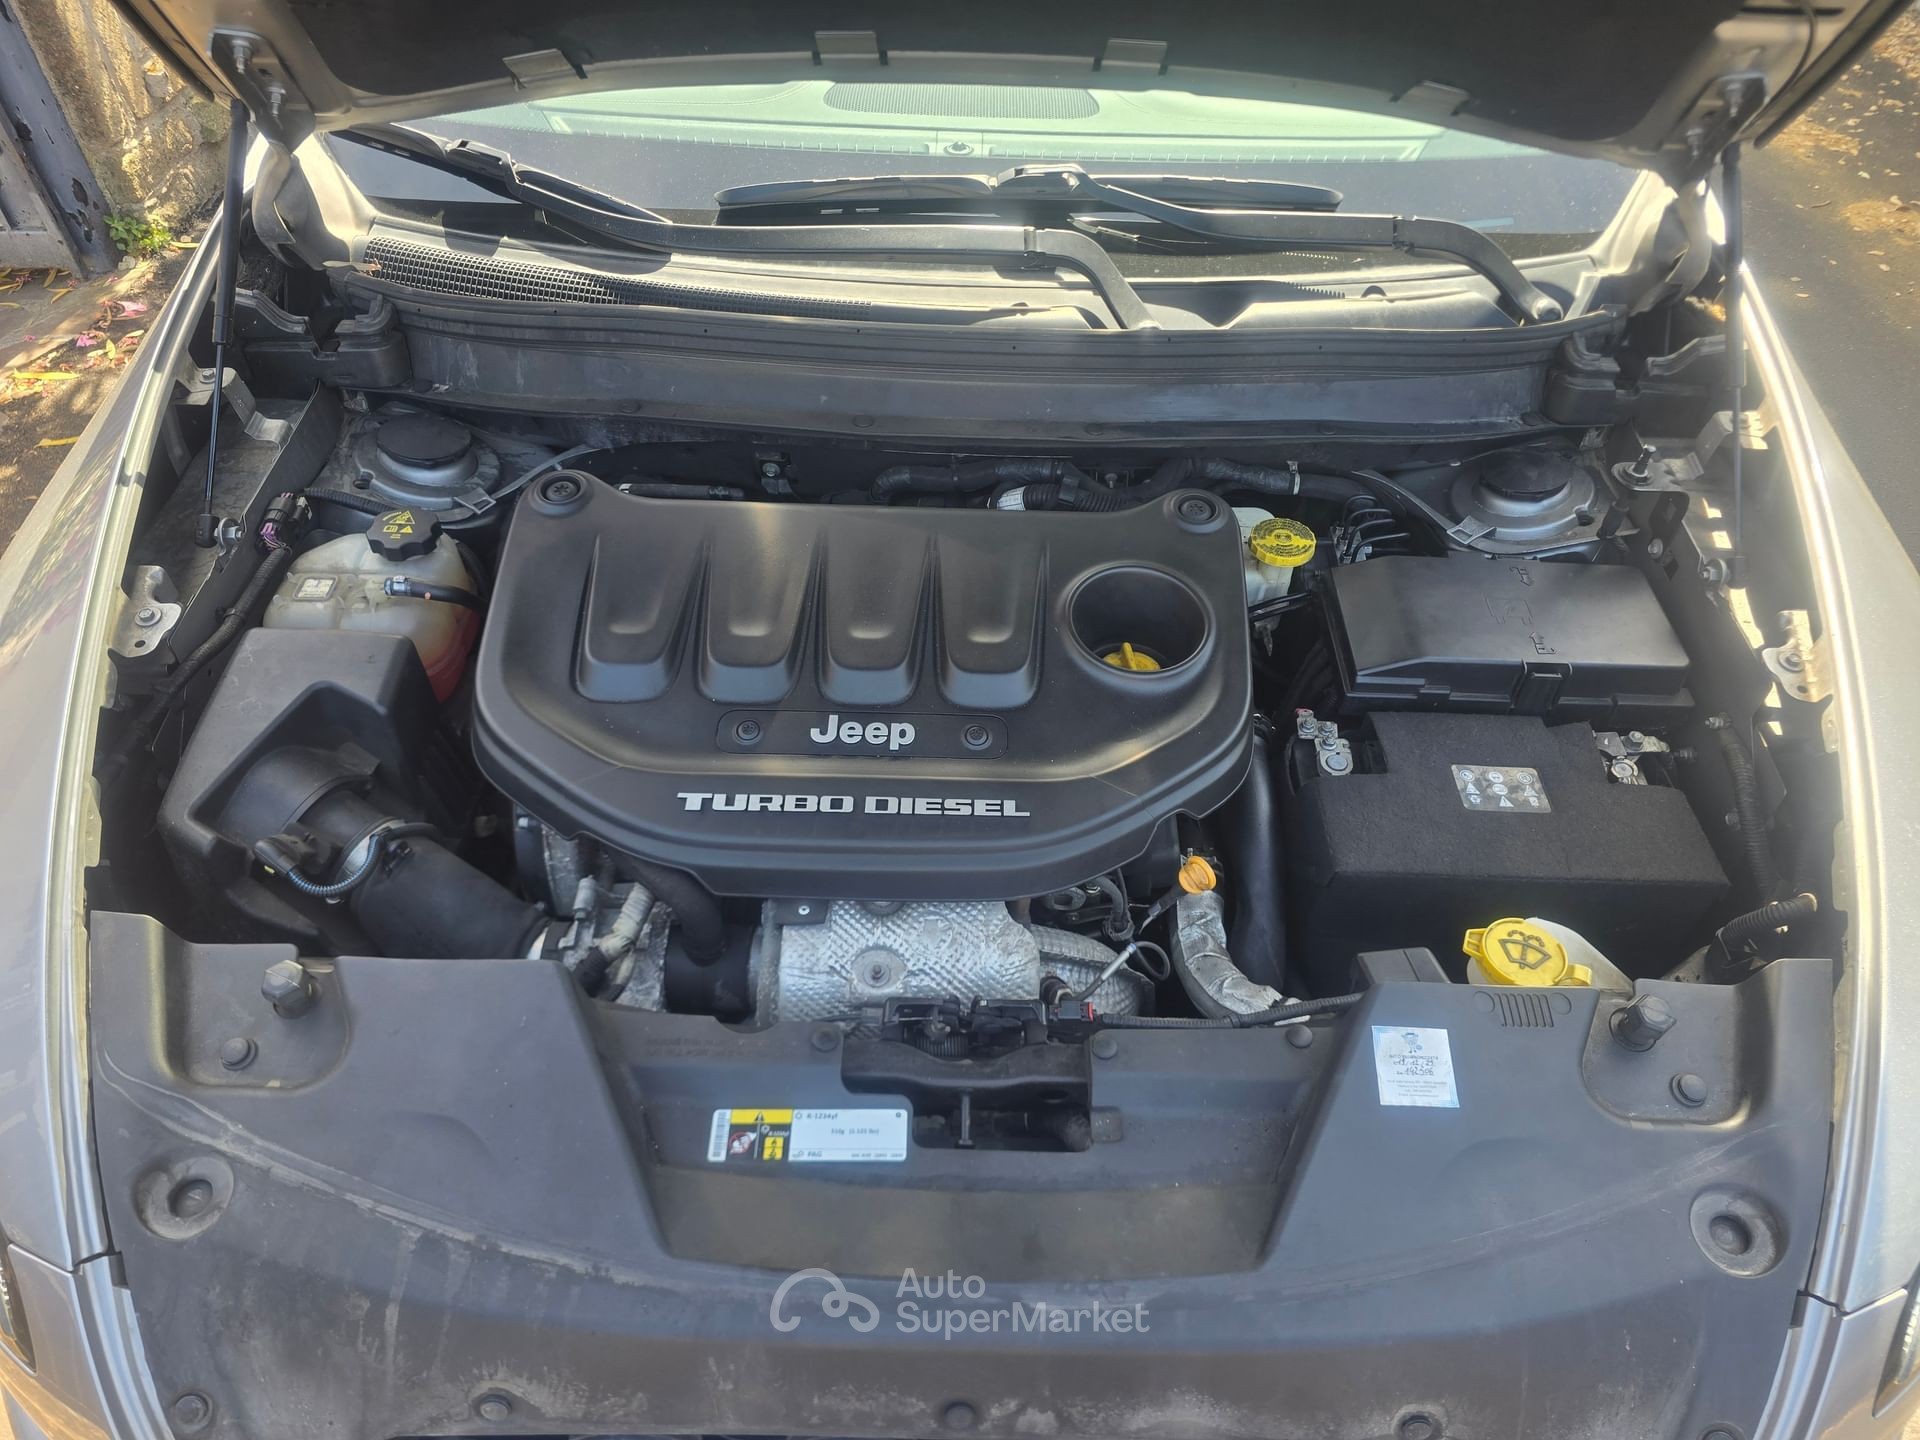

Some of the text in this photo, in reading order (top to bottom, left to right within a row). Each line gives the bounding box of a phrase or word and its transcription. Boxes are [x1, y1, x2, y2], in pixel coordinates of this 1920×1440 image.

[810, 714, 915, 750] Jeep
[677, 792, 1031, 817] TURBO DIESEL
